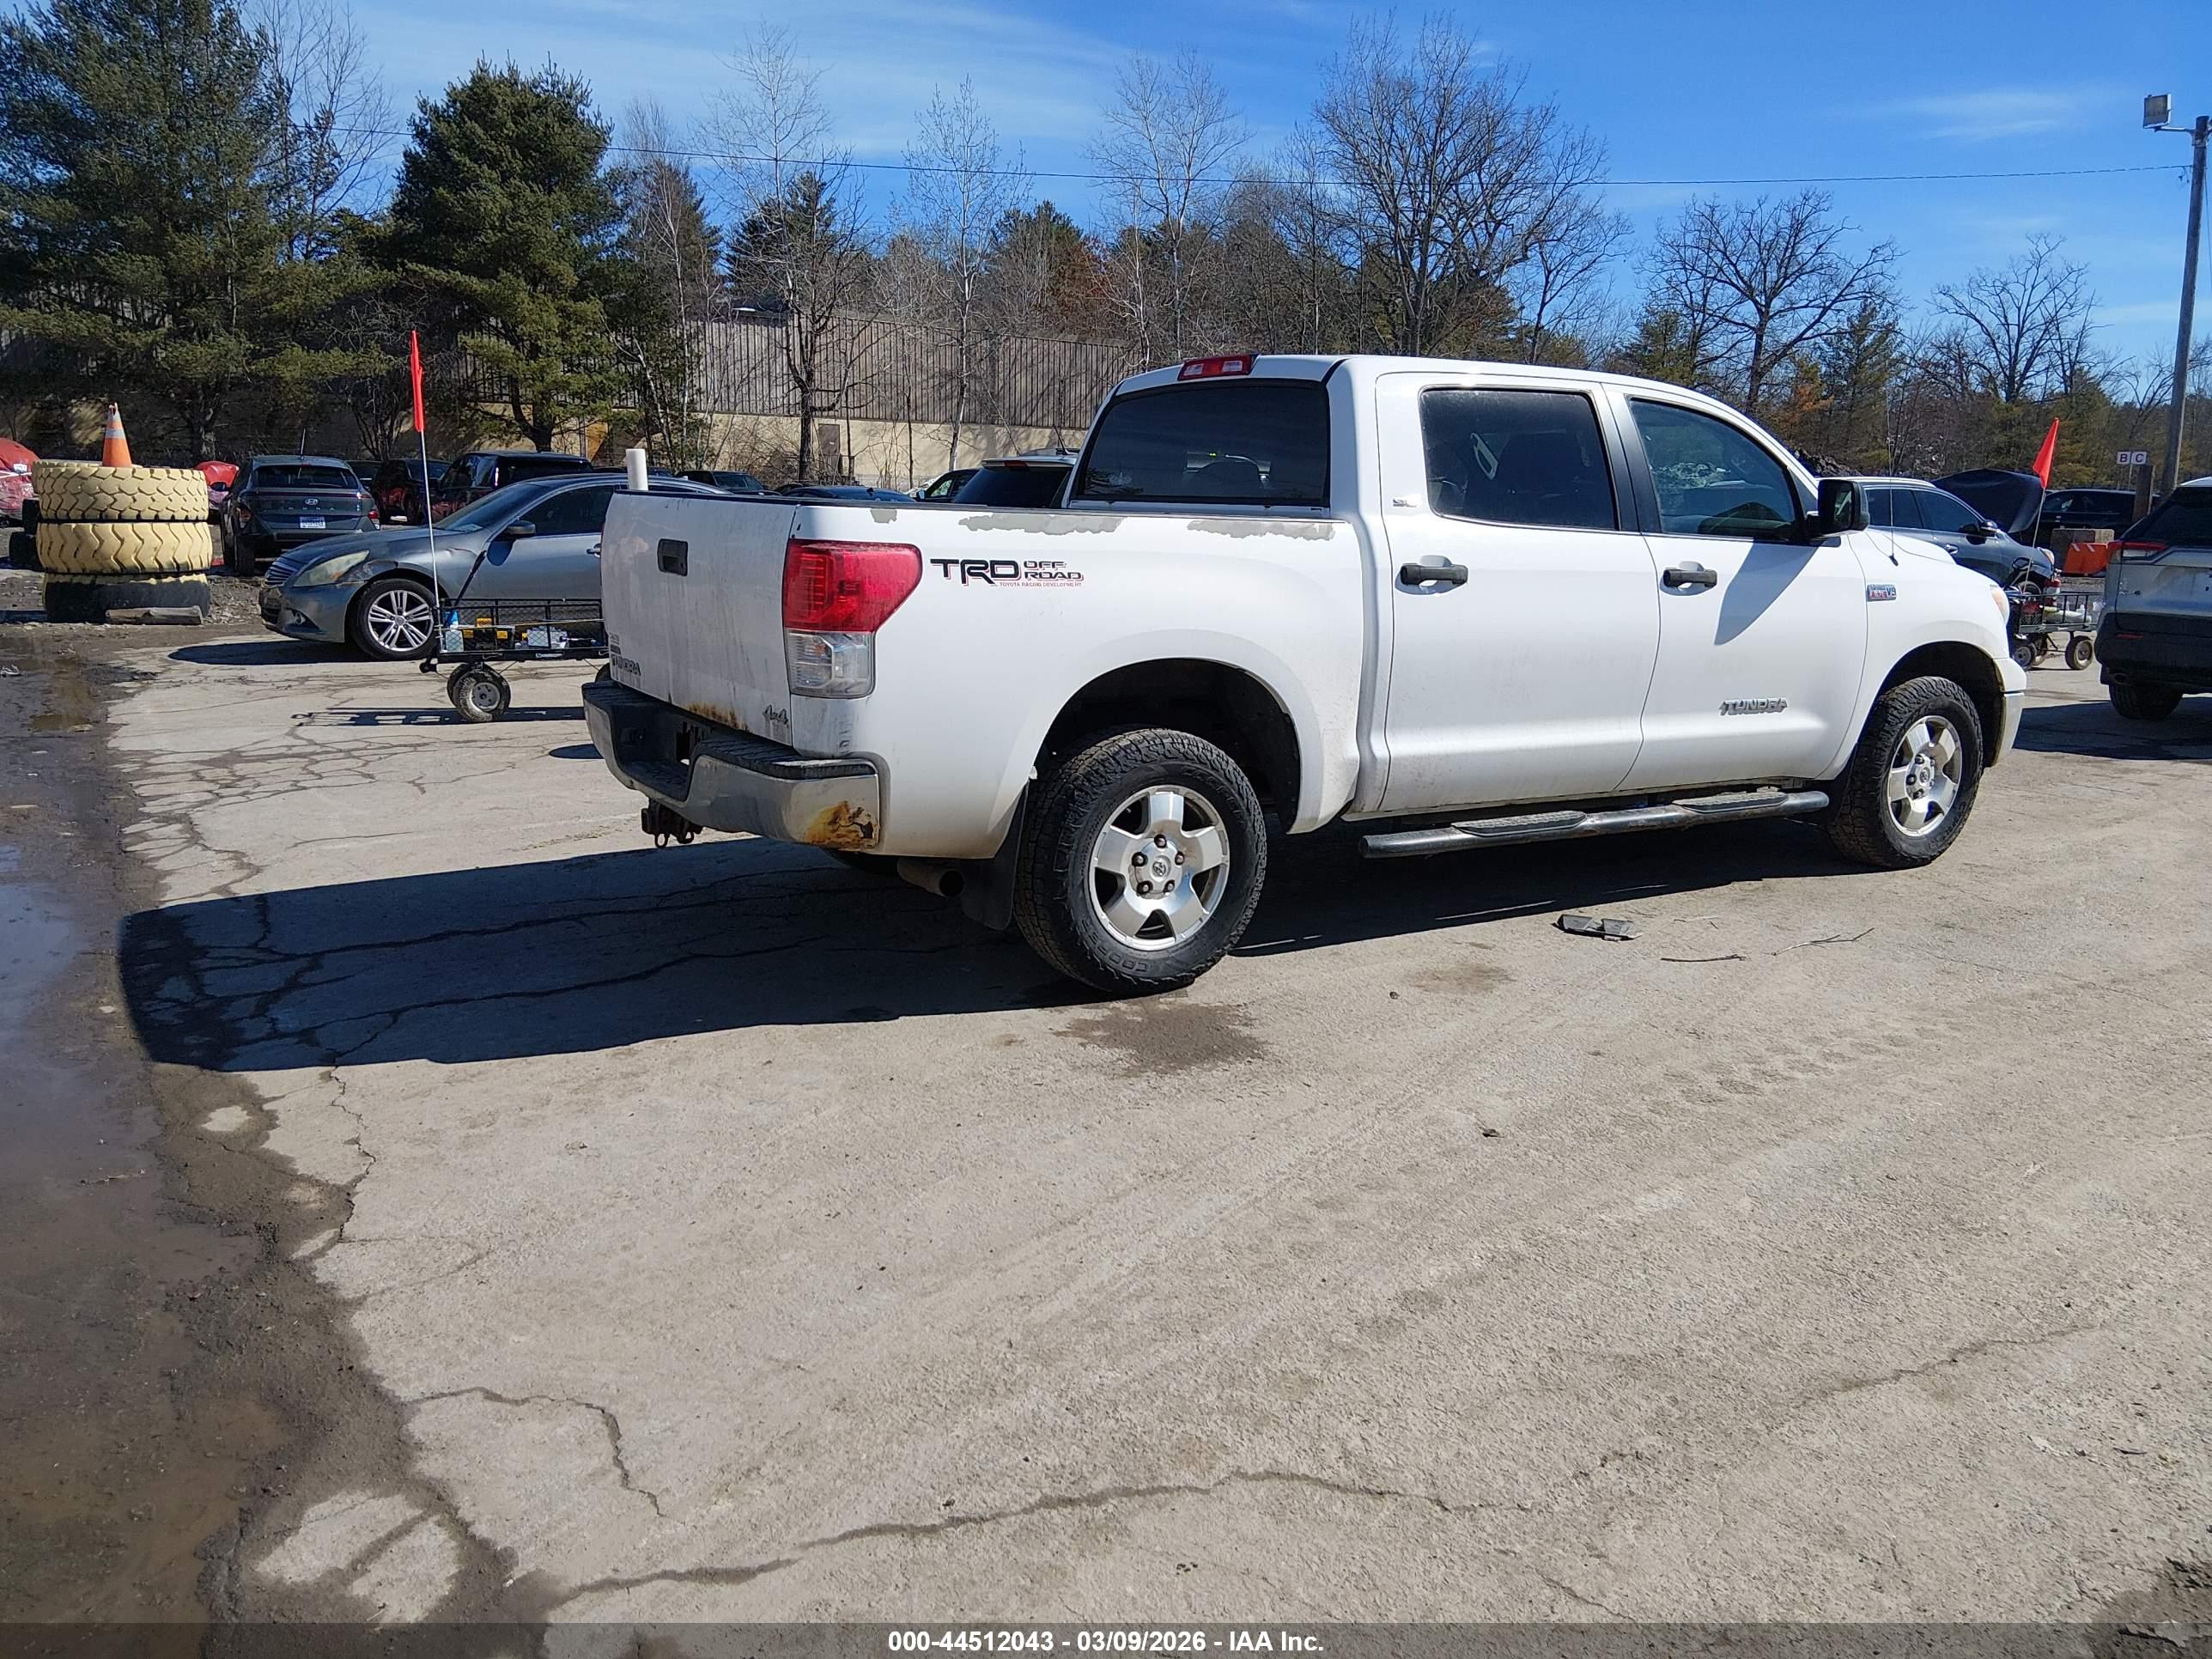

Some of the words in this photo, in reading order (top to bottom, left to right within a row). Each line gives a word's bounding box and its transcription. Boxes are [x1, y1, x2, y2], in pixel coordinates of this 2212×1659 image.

[2119, 453, 2129, 463] B
[2135, 453, 2145, 463] C
[1024, 560, 1066, 570] OFF
[930, 558, 1021, 586] TRD
[1024, 571, 1084, 581] ROAD
[1718, 698, 1788, 716] TUNDRA
